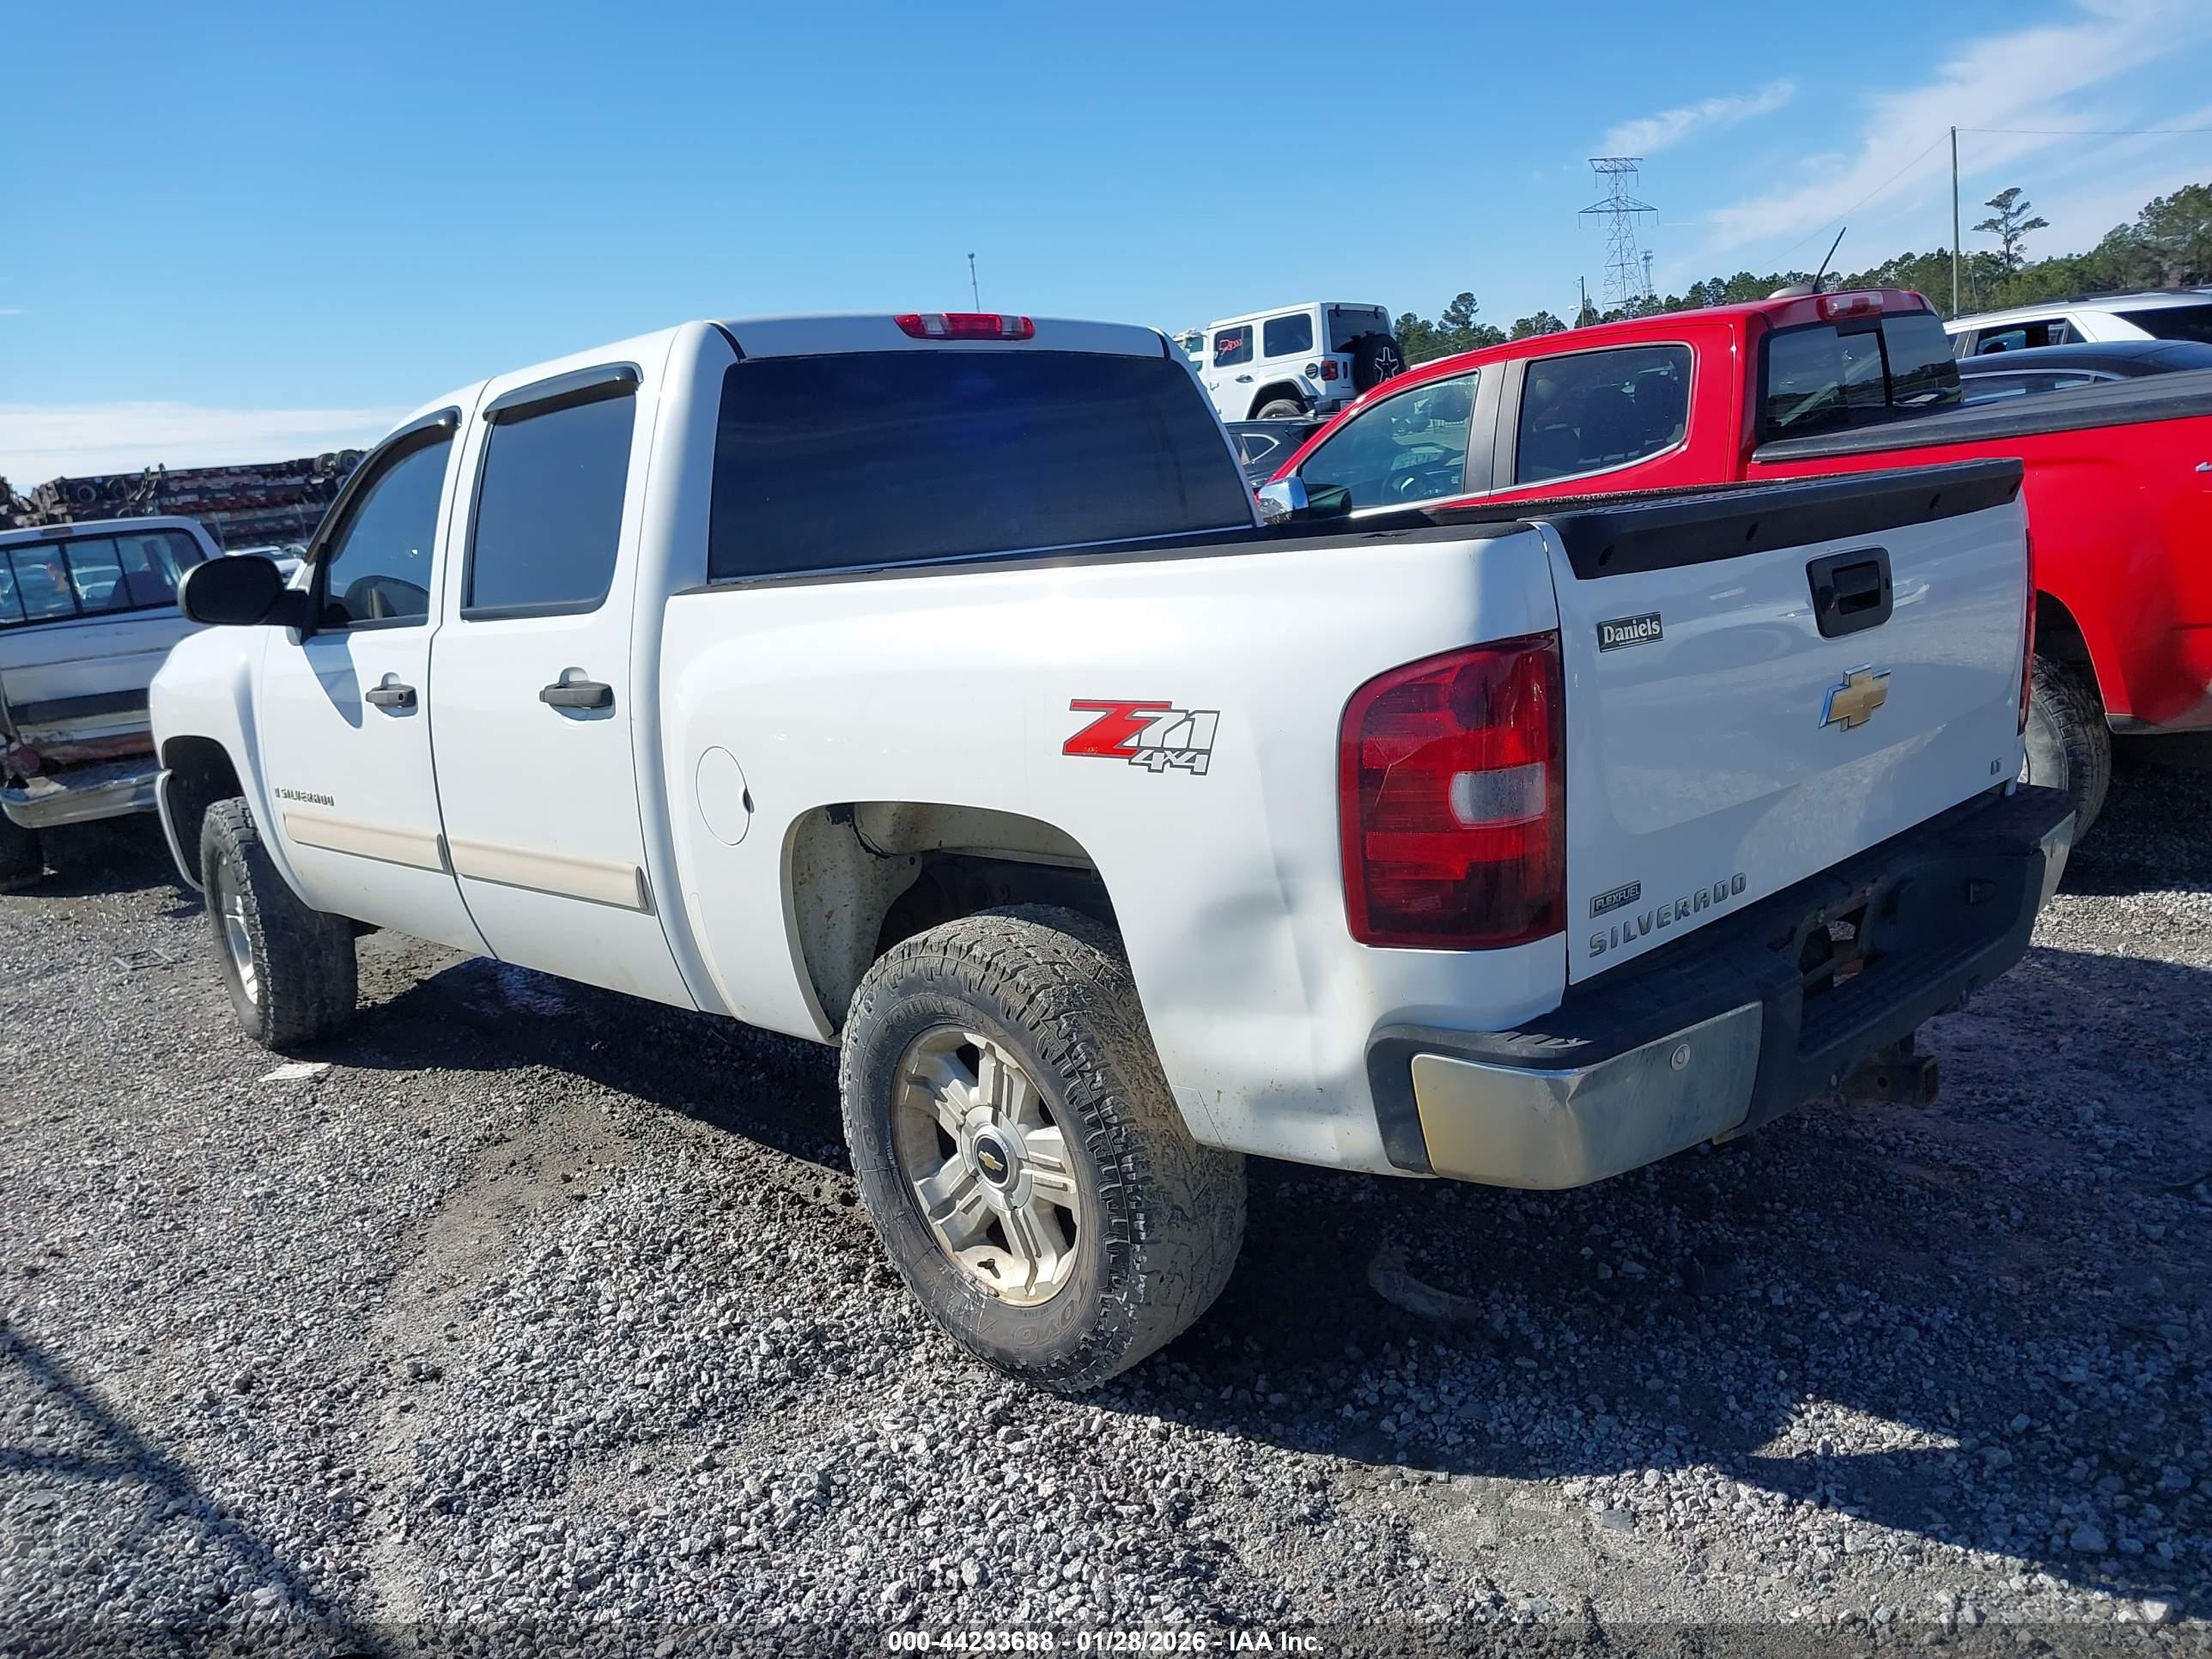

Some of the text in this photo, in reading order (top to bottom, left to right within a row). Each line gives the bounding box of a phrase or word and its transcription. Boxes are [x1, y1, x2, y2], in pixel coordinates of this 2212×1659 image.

[1603, 618, 1661, 644] Daniels
[1062, 699, 1220, 759] Z71
[1589, 872, 1747, 958] SILVERADO
[1595, 885, 1641, 911] FLEXFUEL
[1013, 1276, 1088, 1347] TOYO
